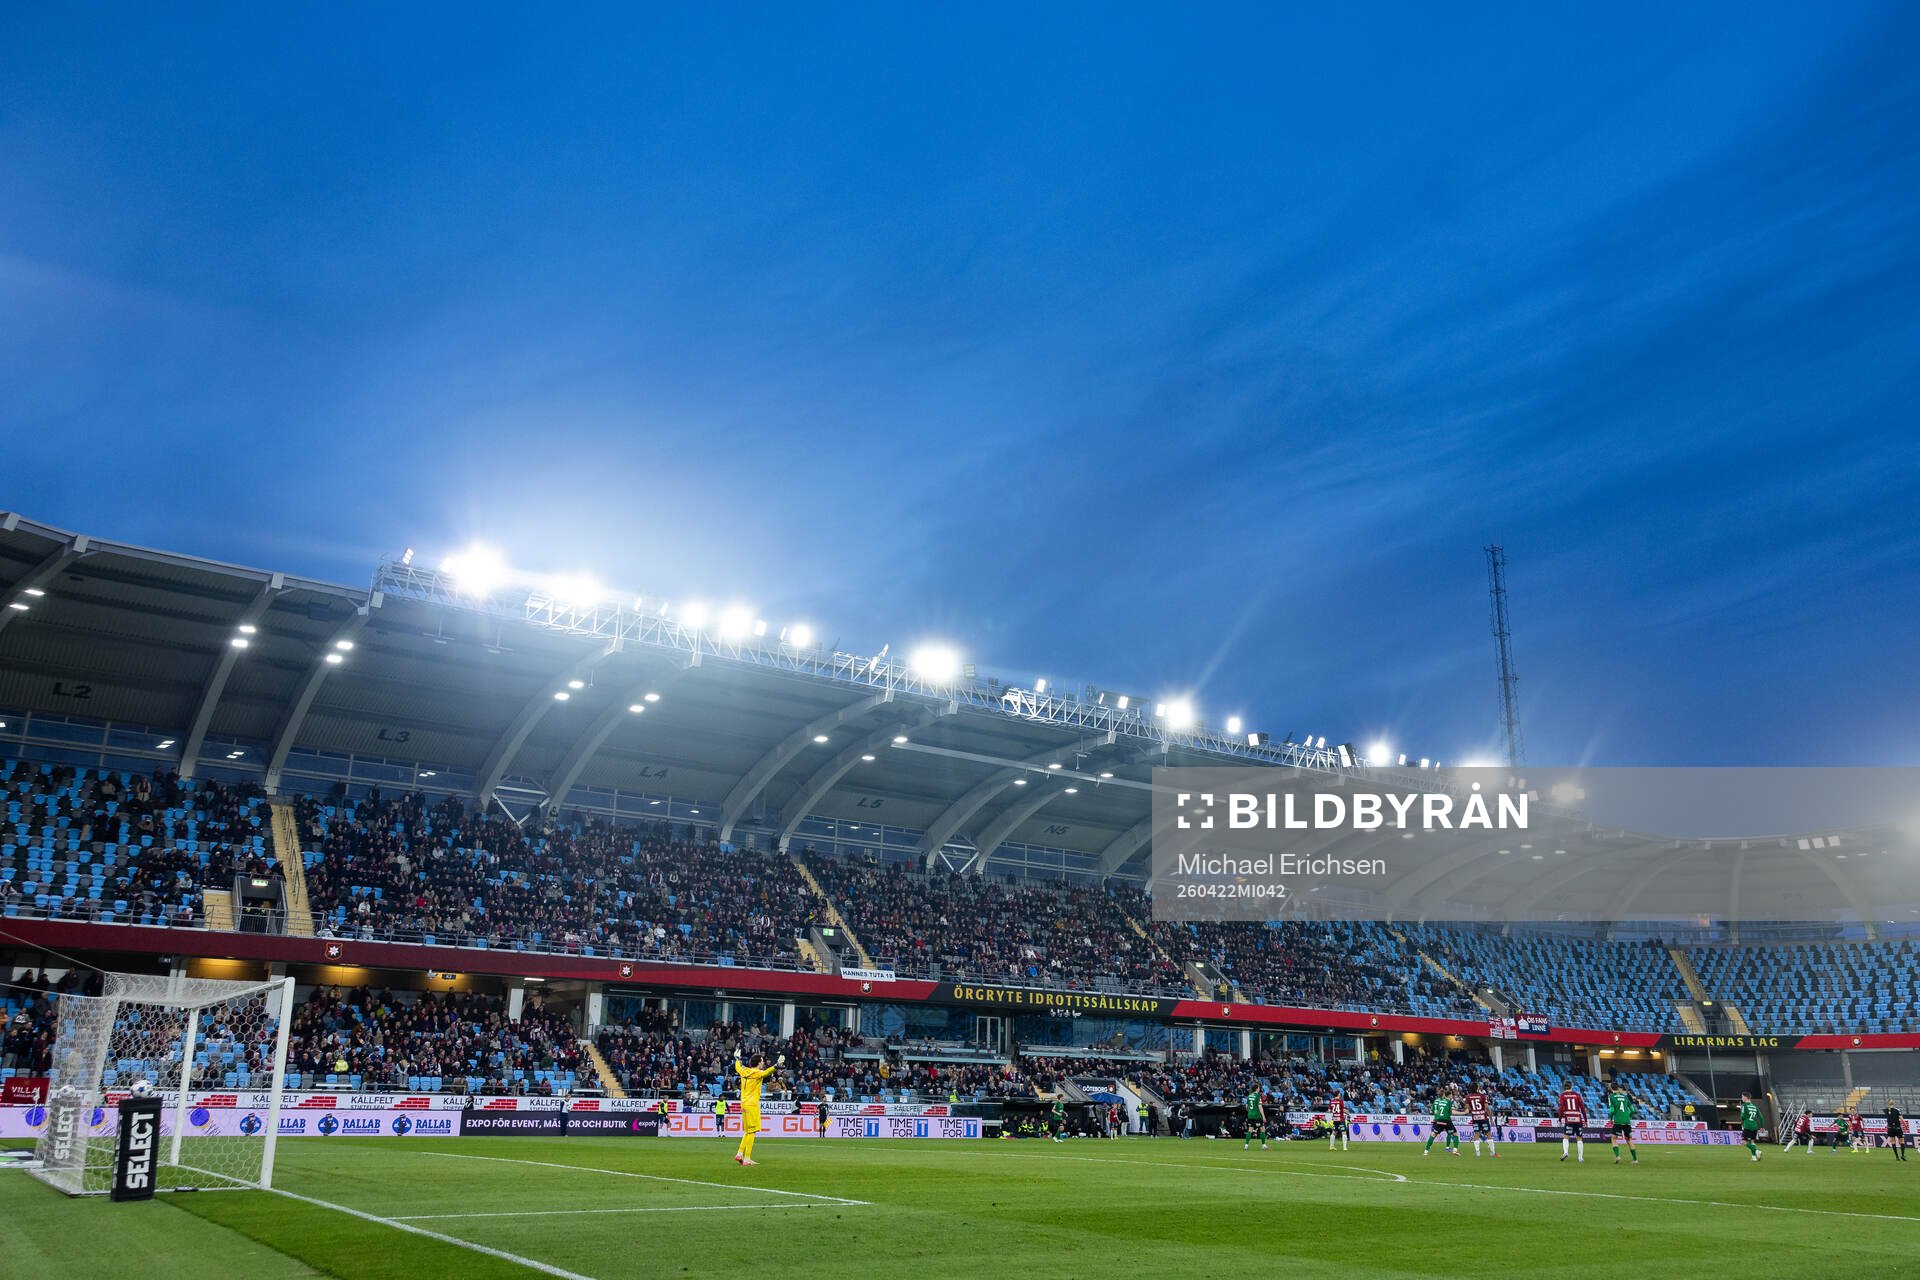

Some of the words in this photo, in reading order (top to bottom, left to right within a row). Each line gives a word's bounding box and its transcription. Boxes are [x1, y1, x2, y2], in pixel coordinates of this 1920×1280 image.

[52, 681, 92, 699] L2
[378, 728, 410, 743] L3
[640, 766, 669, 780] L4
[857, 796, 884, 809] L5
[953, 985, 1023, 1003] ÖRGRYTE
[1029, 991, 1158, 1012] IDROTTSSÄLLSKAP
[1674, 1036, 1744, 1047] LIRARNAS
[1750, 1037, 1778, 1047] LAG
[1331, 1103, 1340, 1113] 24
[1471, 1099, 1482, 1111] 15
[1567, 1098, 1576, 1110] 11
[342, 1118, 381, 1129] RALLAB
[415, 1119, 452, 1129] RALLAB
[466, 1119, 491, 1128] EXPO
[493, 1118, 510, 1128] FÖR
[511, 1119, 542, 1130] EVENT,
[543, 1118, 581, 1128] MÄSOR
[582, 1119, 601, 1128] OCH
[603, 1120, 627, 1128] BUTIK
[836, 1117, 862, 1127] TIME
[888, 1118, 913, 1128] TIME
[938, 1119, 962, 1128] TIME
[54, 1106, 76, 1160] SELECT
[841, 1128, 862, 1137] FOR
[892, 1129, 912, 1137] FOR
[942, 1129, 962, 1138] FOR
[1641, 1130, 1661, 1141] GLC
[1666, 1131, 1685, 1141] GLC
[126, 1112, 155, 1189] SELECT
